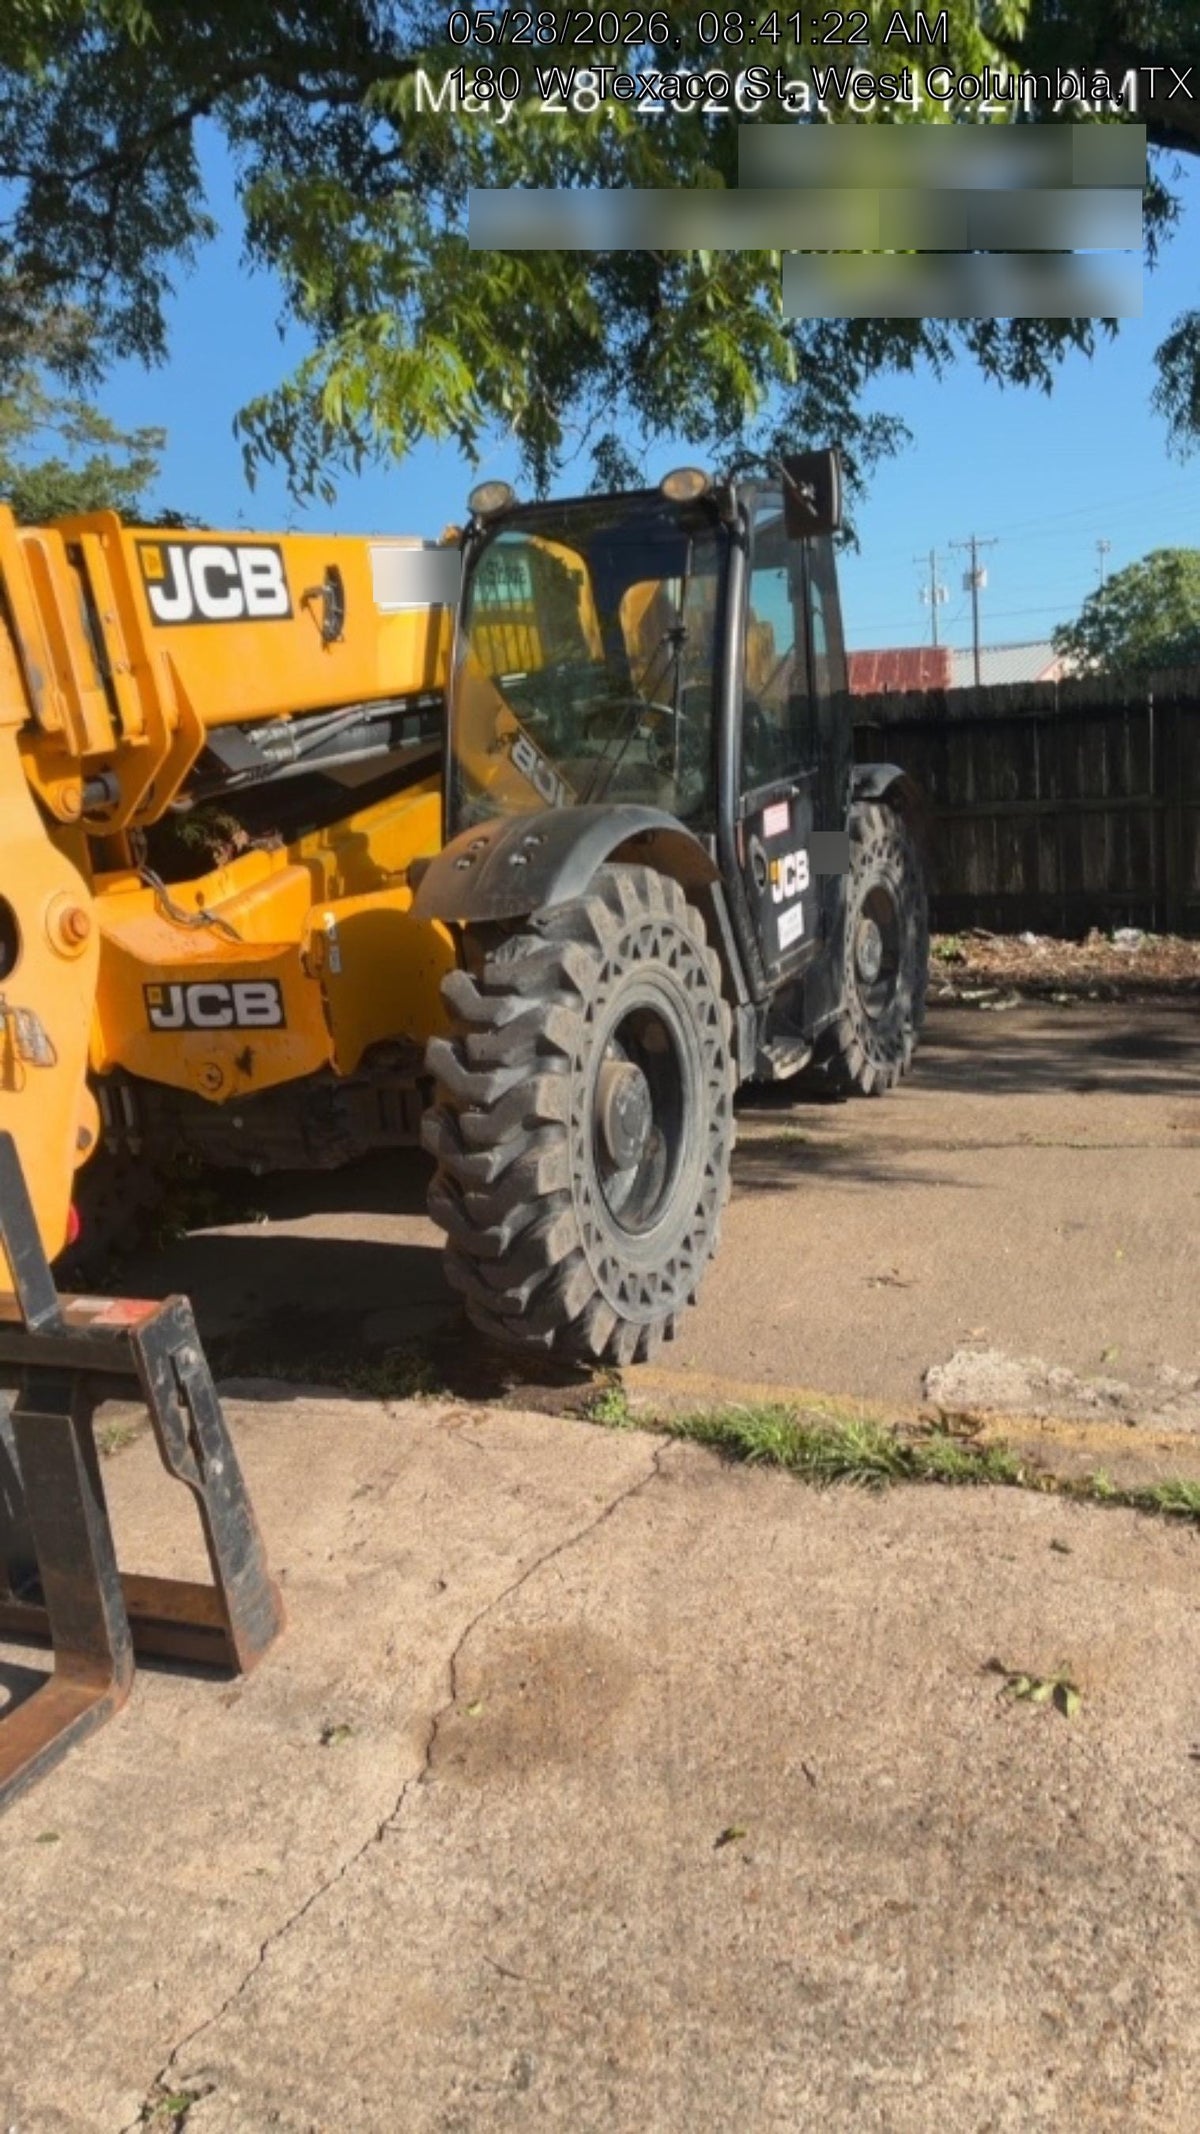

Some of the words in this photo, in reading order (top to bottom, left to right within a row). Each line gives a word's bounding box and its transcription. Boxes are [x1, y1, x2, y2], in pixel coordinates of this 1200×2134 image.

[148, 544, 289, 621] JCB
[771, 849, 810, 904] JCB
[150, 982, 283, 1028] JCB
